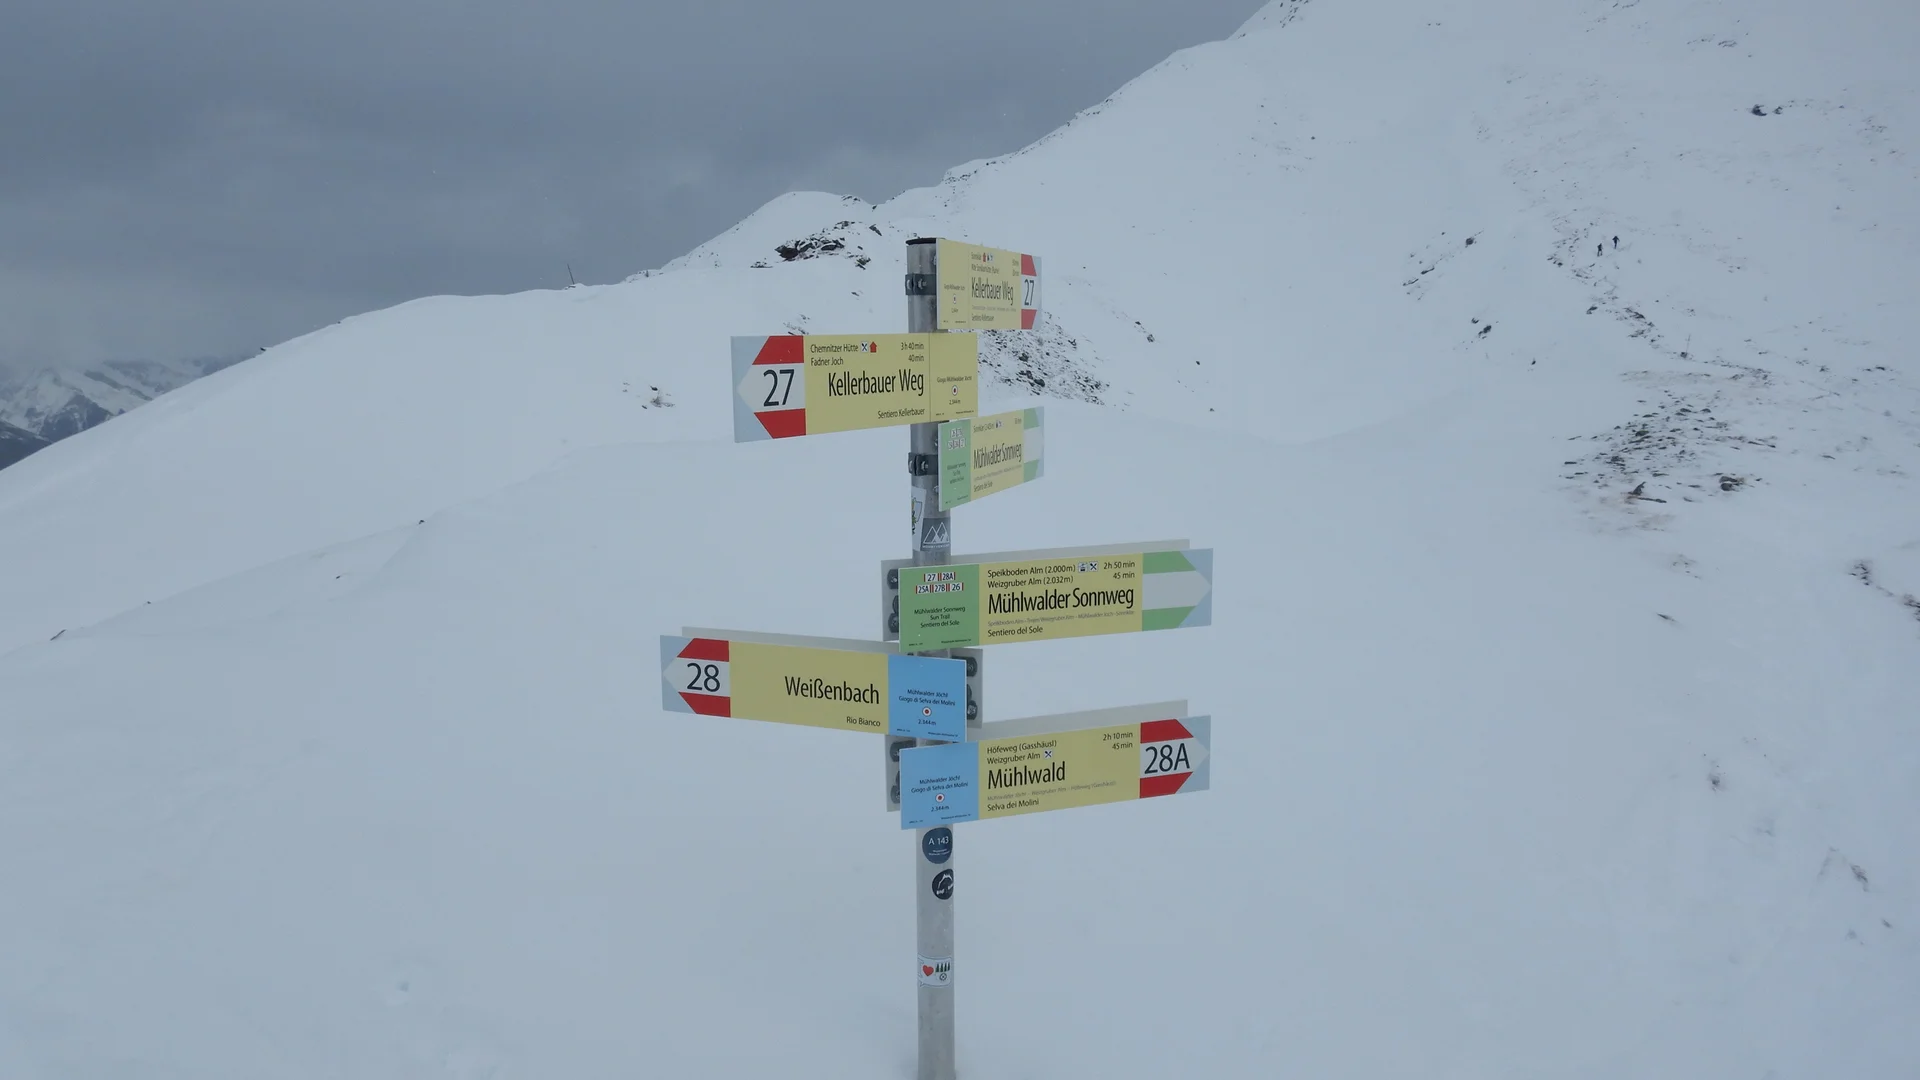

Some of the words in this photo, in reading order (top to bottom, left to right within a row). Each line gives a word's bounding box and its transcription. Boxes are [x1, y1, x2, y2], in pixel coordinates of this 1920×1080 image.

[971, 277, 1001, 300] Kellerbauer
[1002, 280, 1014, 306] Weg
[1024, 279, 1035, 306] 27
[810, 343, 842, 353] Chemnitzer
[843, 342, 859, 352] Hütte
[810, 357, 831, 366] Fadner
[831, 356, 844, 366] Joch
[763, 368, 795, 407] 27
[828, 370, 896, 397] Kellerbauer
[898, 368, 924, 397] Weg
[878, 410, 898, 419] Sentiero
[898, 408, 925, 417] Kellerbauer
[973, 444, 1001, 470] Mühlwalder
[1001, 442, 1022, 463] Sonnweg
[987, 568, 1028, 578] Speikboden
[1030, 566, 1043, 575] Alm
[1045, 564, 1076, 574] (2.000m)
[1114, 561, 1122, 569] 50
[1122, 560, 1135, 568] min
[927, 573, 936, 582] 27
[942, 572, 954, 581] 28A
[1122, 571, 1135, 579] min
[918, 585, 930, 593] 25A
[934, 584, 946, 592] 27B
[951, 583, 961, 591] 26
[987, 579, 1027, 589] Weizgruber
[1028, 577, 1041, 585] Alm
[1043, 575, 1073, 585] (2.032m)
[988, 588, 1071, 614] Mühlwalder
[1072, 587, 1134, 609] Sonnweg
[914, 607, 942, 615] Mühlwalder
[987, 628, 1016, 637] Sentiero
[1016, 626, 1027, 635] del
[1028, 625, 1043, 634] Sole
[686, 662, 721, 692] 28
[784, 676, 880, 704] Weißenbach
[907, 689, 935, 697] Mühlwalder
[846, 715, 858, 725] Rio
[858, 717, 881, 727] Bianco
[987, 745, 1018, 754] Höfeweg
[1019, 740, 1057, 752] (Gasshäusl)
[987, 754, 1025, 765] Weizgruber
[1027, 752, 1041, 760] Alm
[1144, 742, 1191, 775] 28A
[919, 776, 947, 784] Mühlwalder
[987, 760, 1066, 790] Mühlwald
[987, 803, 1005, 812] Selva
[1006, 801, 1017, 809] dei
[1018, 798, 1040, 808] Molini
[928, 837, 935, 845] A
[937, 836, 949, 845] 143
